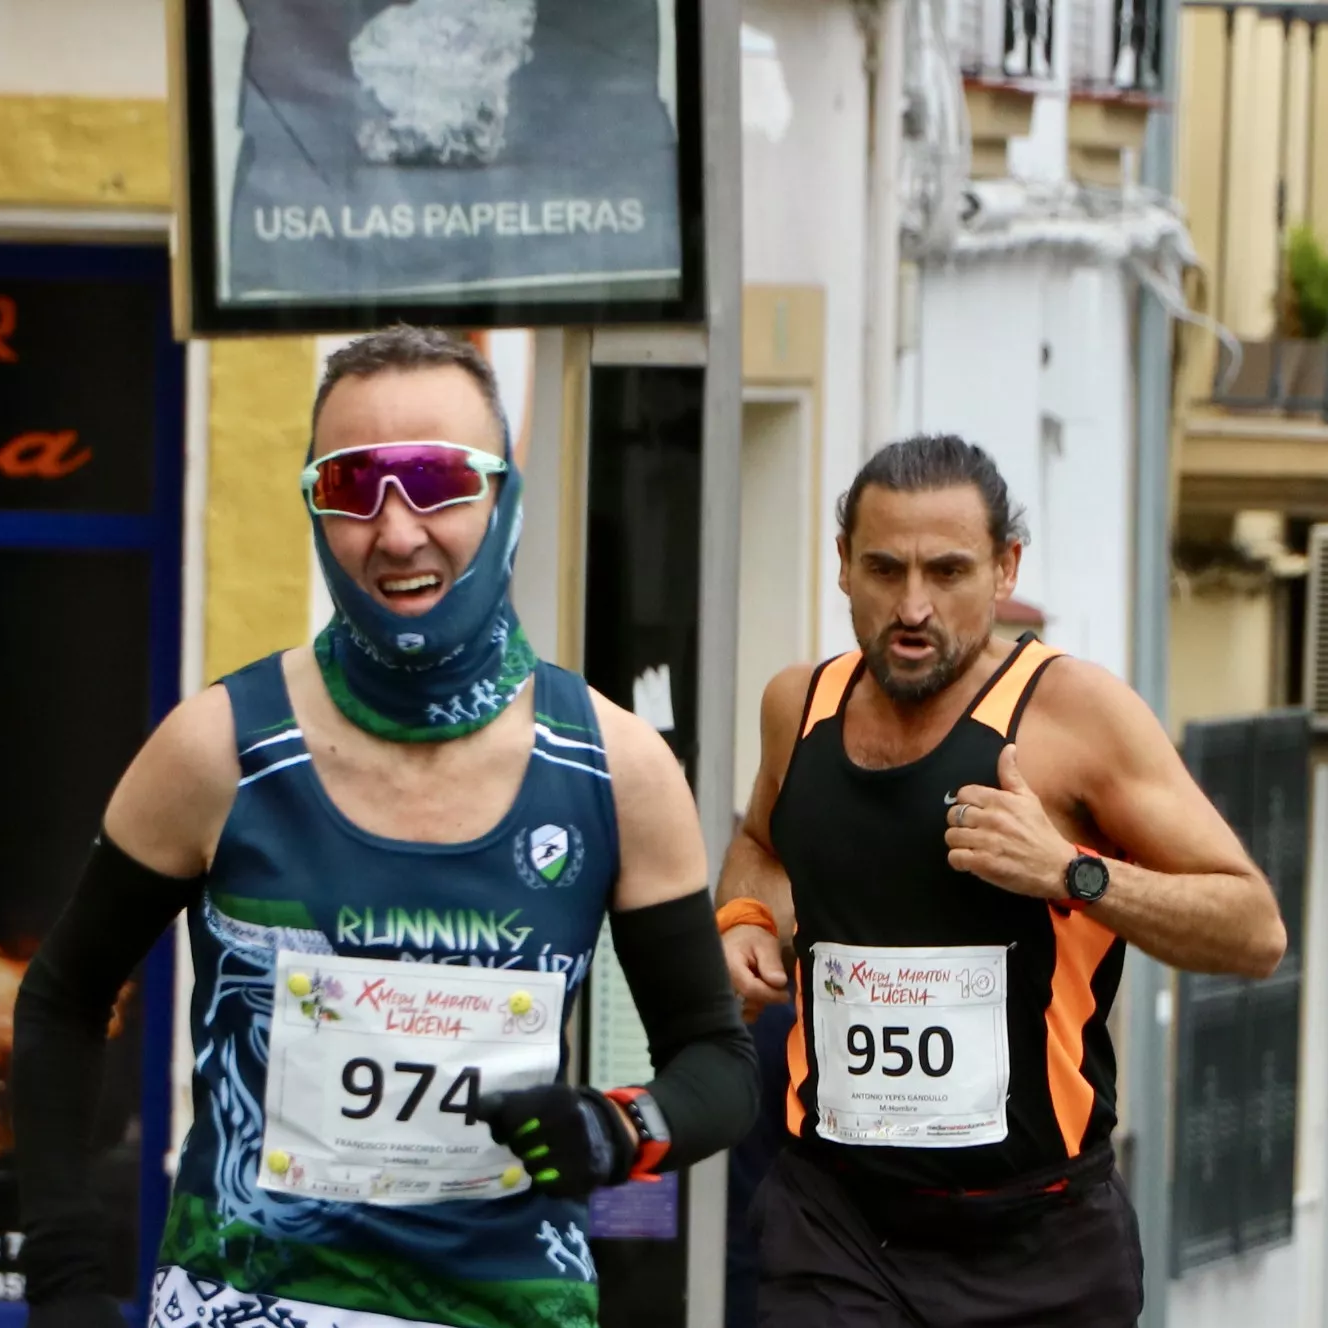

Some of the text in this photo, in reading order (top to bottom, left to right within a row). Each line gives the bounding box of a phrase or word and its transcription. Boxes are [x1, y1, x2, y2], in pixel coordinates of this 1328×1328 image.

[254, 198, 645, 241] USA LAS PAPELERAS
[337, 905, 534, 951] RUNNING
[870, 984, 938, 1006] LUCENA
[385, 1008, 474, 1038] LUCENA
[847, 1024, 954, 1077] 950
[341, 1057, 482, 1126] 974
[851, 1092, 883, 1101] ANTONIO
[884, 1094, 906, 1102] YEPES
